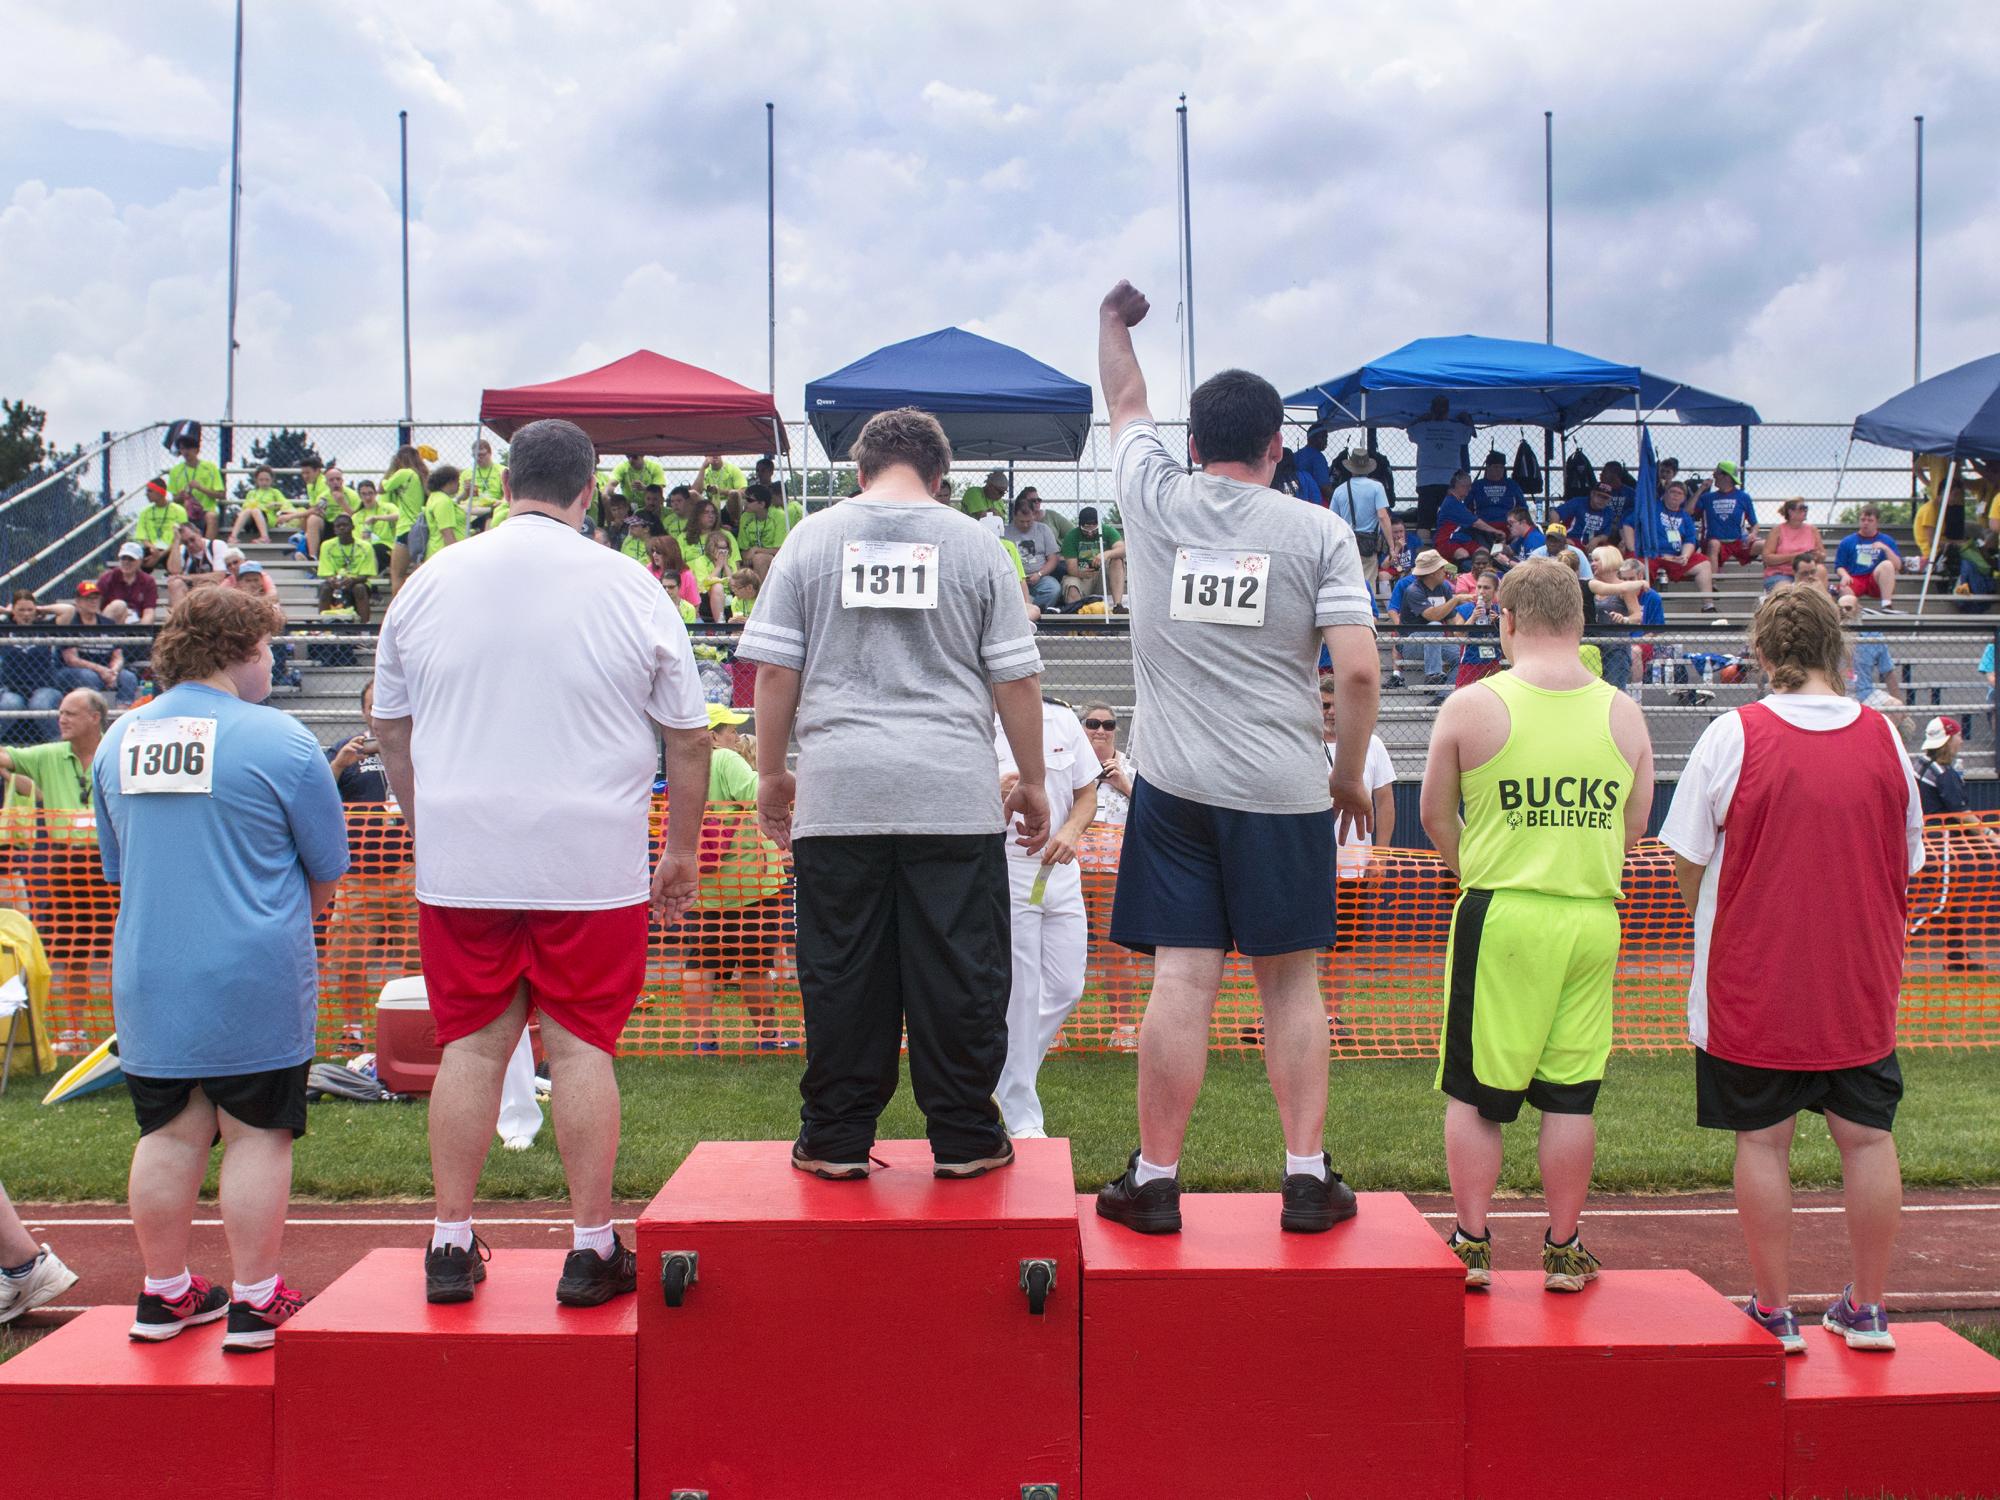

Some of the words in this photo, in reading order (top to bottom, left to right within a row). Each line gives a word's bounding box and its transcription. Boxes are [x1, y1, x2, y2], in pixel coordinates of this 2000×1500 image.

[851, 564, 926, 595] 1311
[1181, 573, 1259, 609] 1312
[128, 741, 205, 777] 1306
[1498, 776, 1620, 811] BUCKS
[1526, 809, 1612, 830] BELIEVERS
